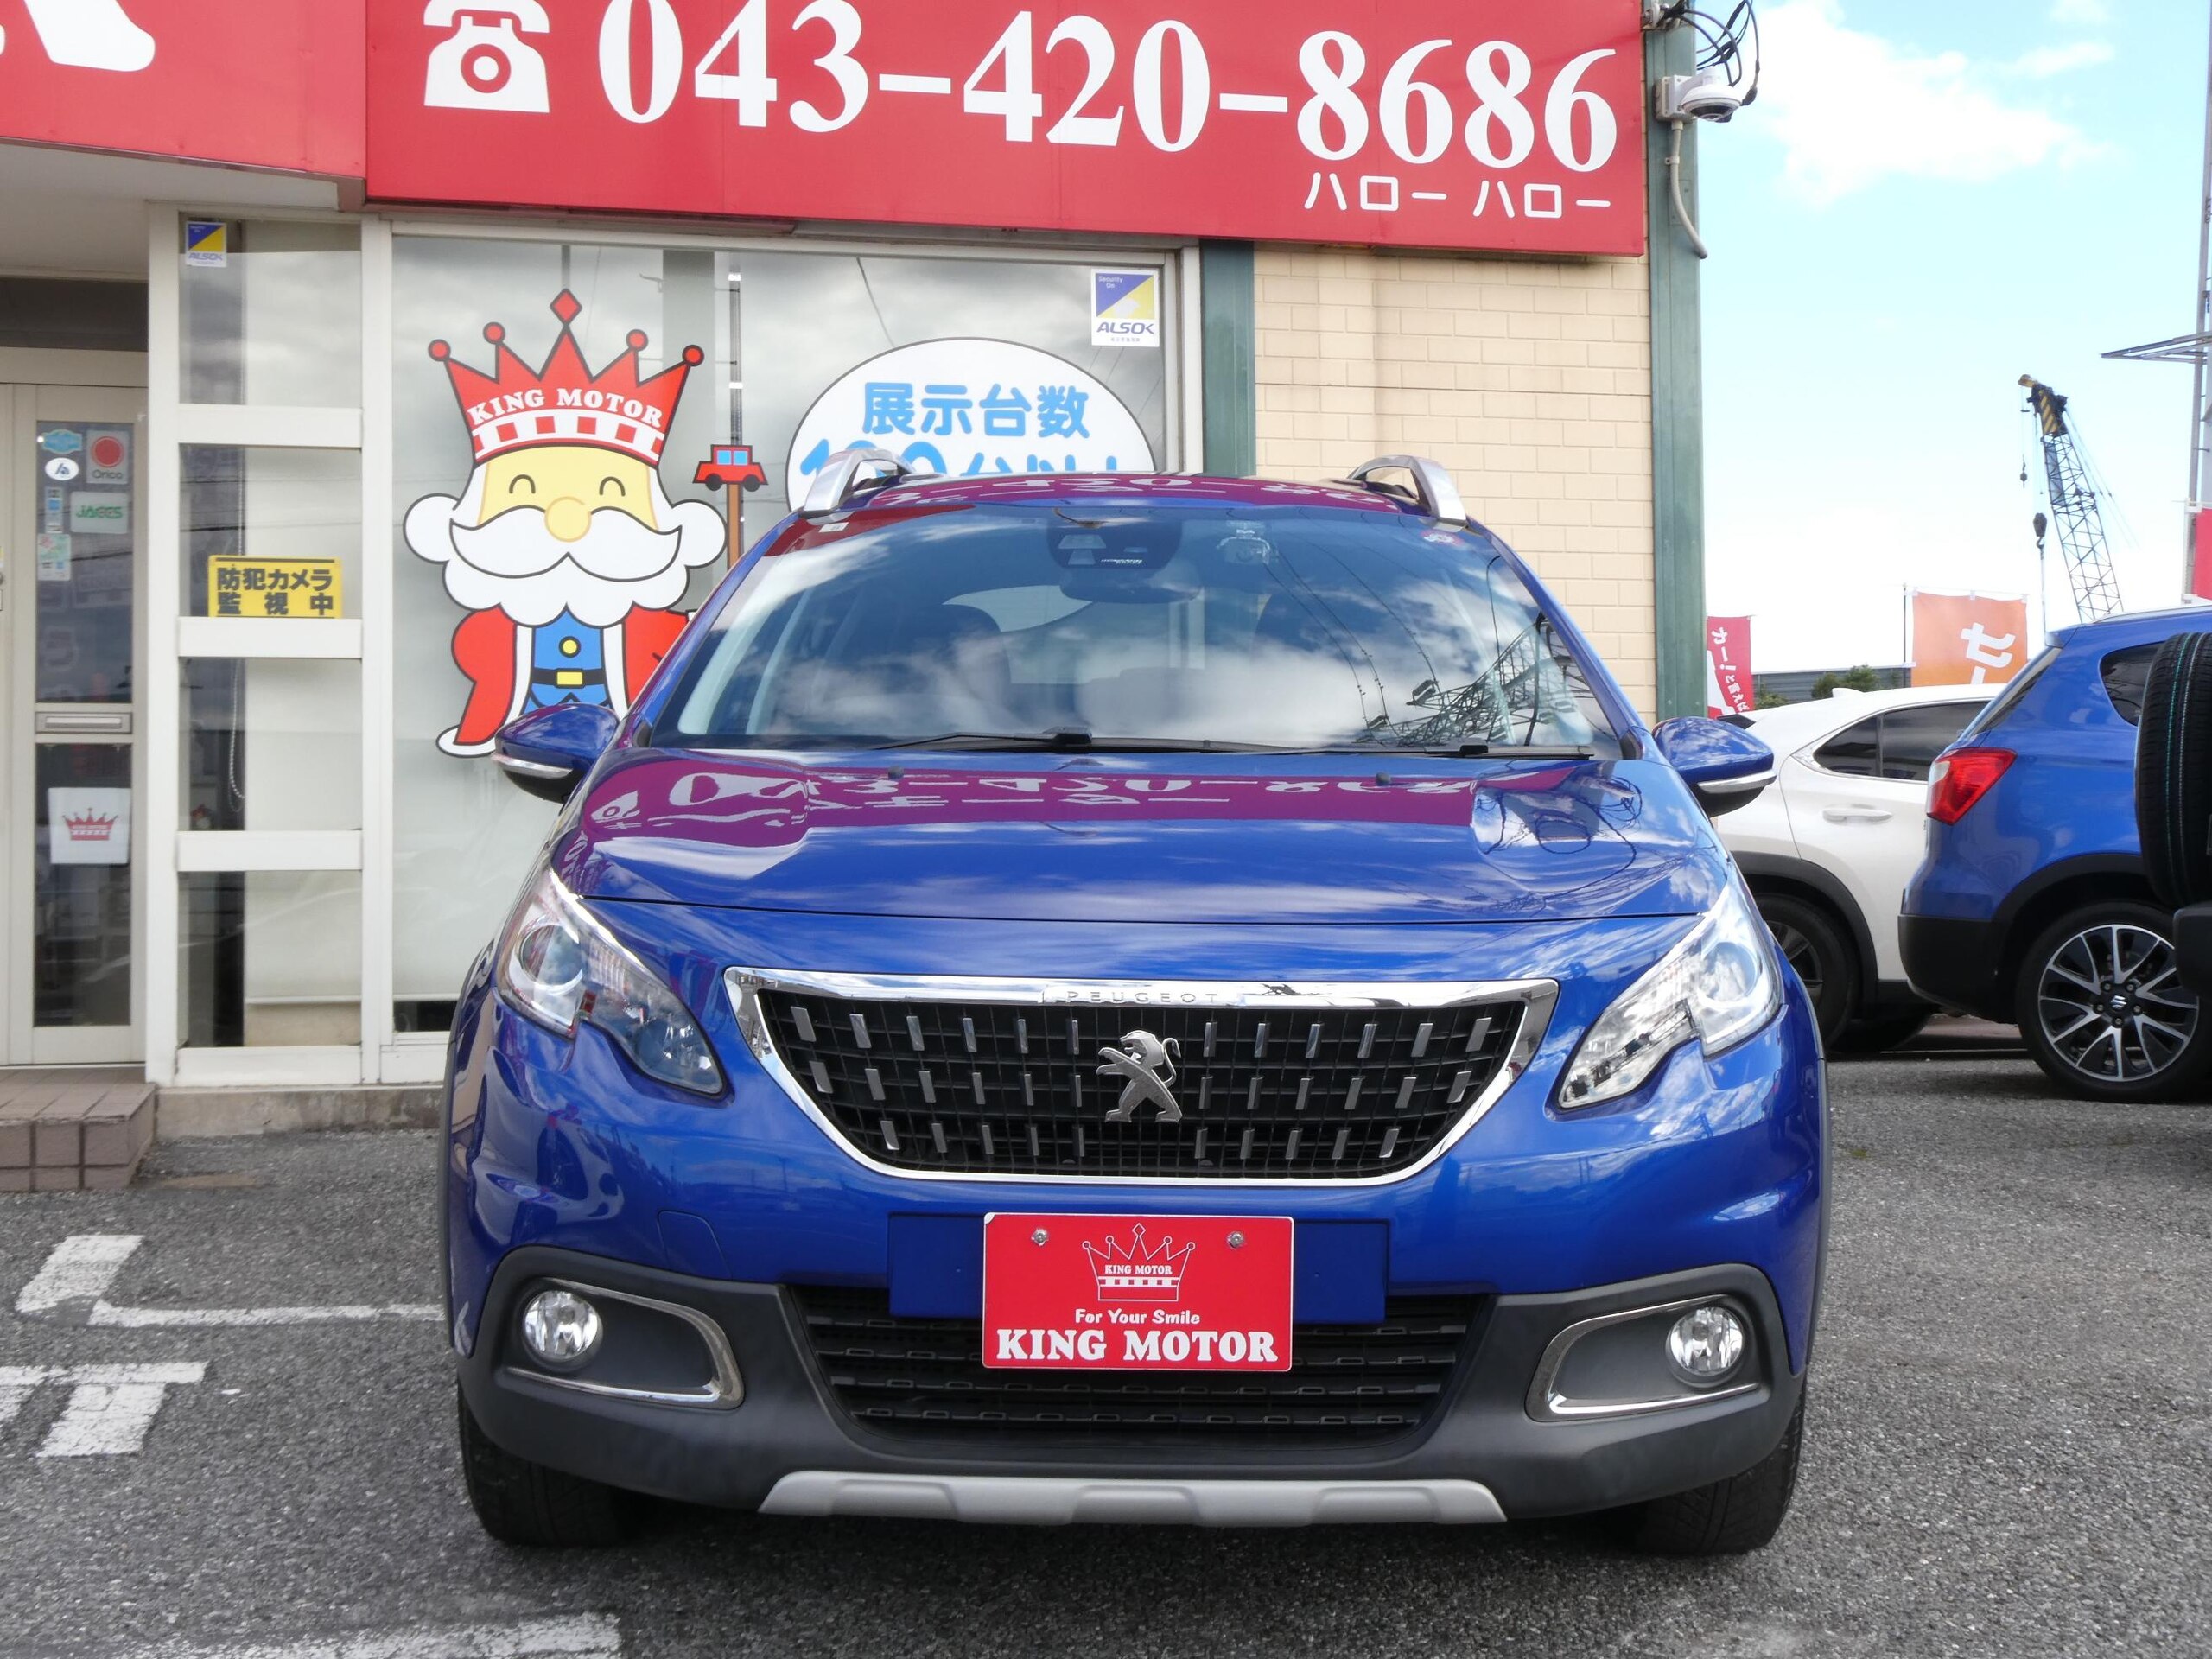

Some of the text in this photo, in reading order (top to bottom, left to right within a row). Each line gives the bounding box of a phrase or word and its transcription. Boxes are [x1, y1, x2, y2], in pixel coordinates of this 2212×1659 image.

[599, 0, 1618, 173] 043-420-8686
[1096, 321, 1154, 334] ALSOK
[467, 388, 664, 429] KING MOTOR
[861, 382, 1090, 439] 展示台数
[217, 567, 333, 592] 防犯カメラ
[1067, 991, 1218, 1004] PEUGEOT
[1104, 1265, 1173, 1275] KING MOTOR
[1075, 1308, 1200, 1325] For Your Smile
[996, 1329, 1278, 1363] KING MOTOR
